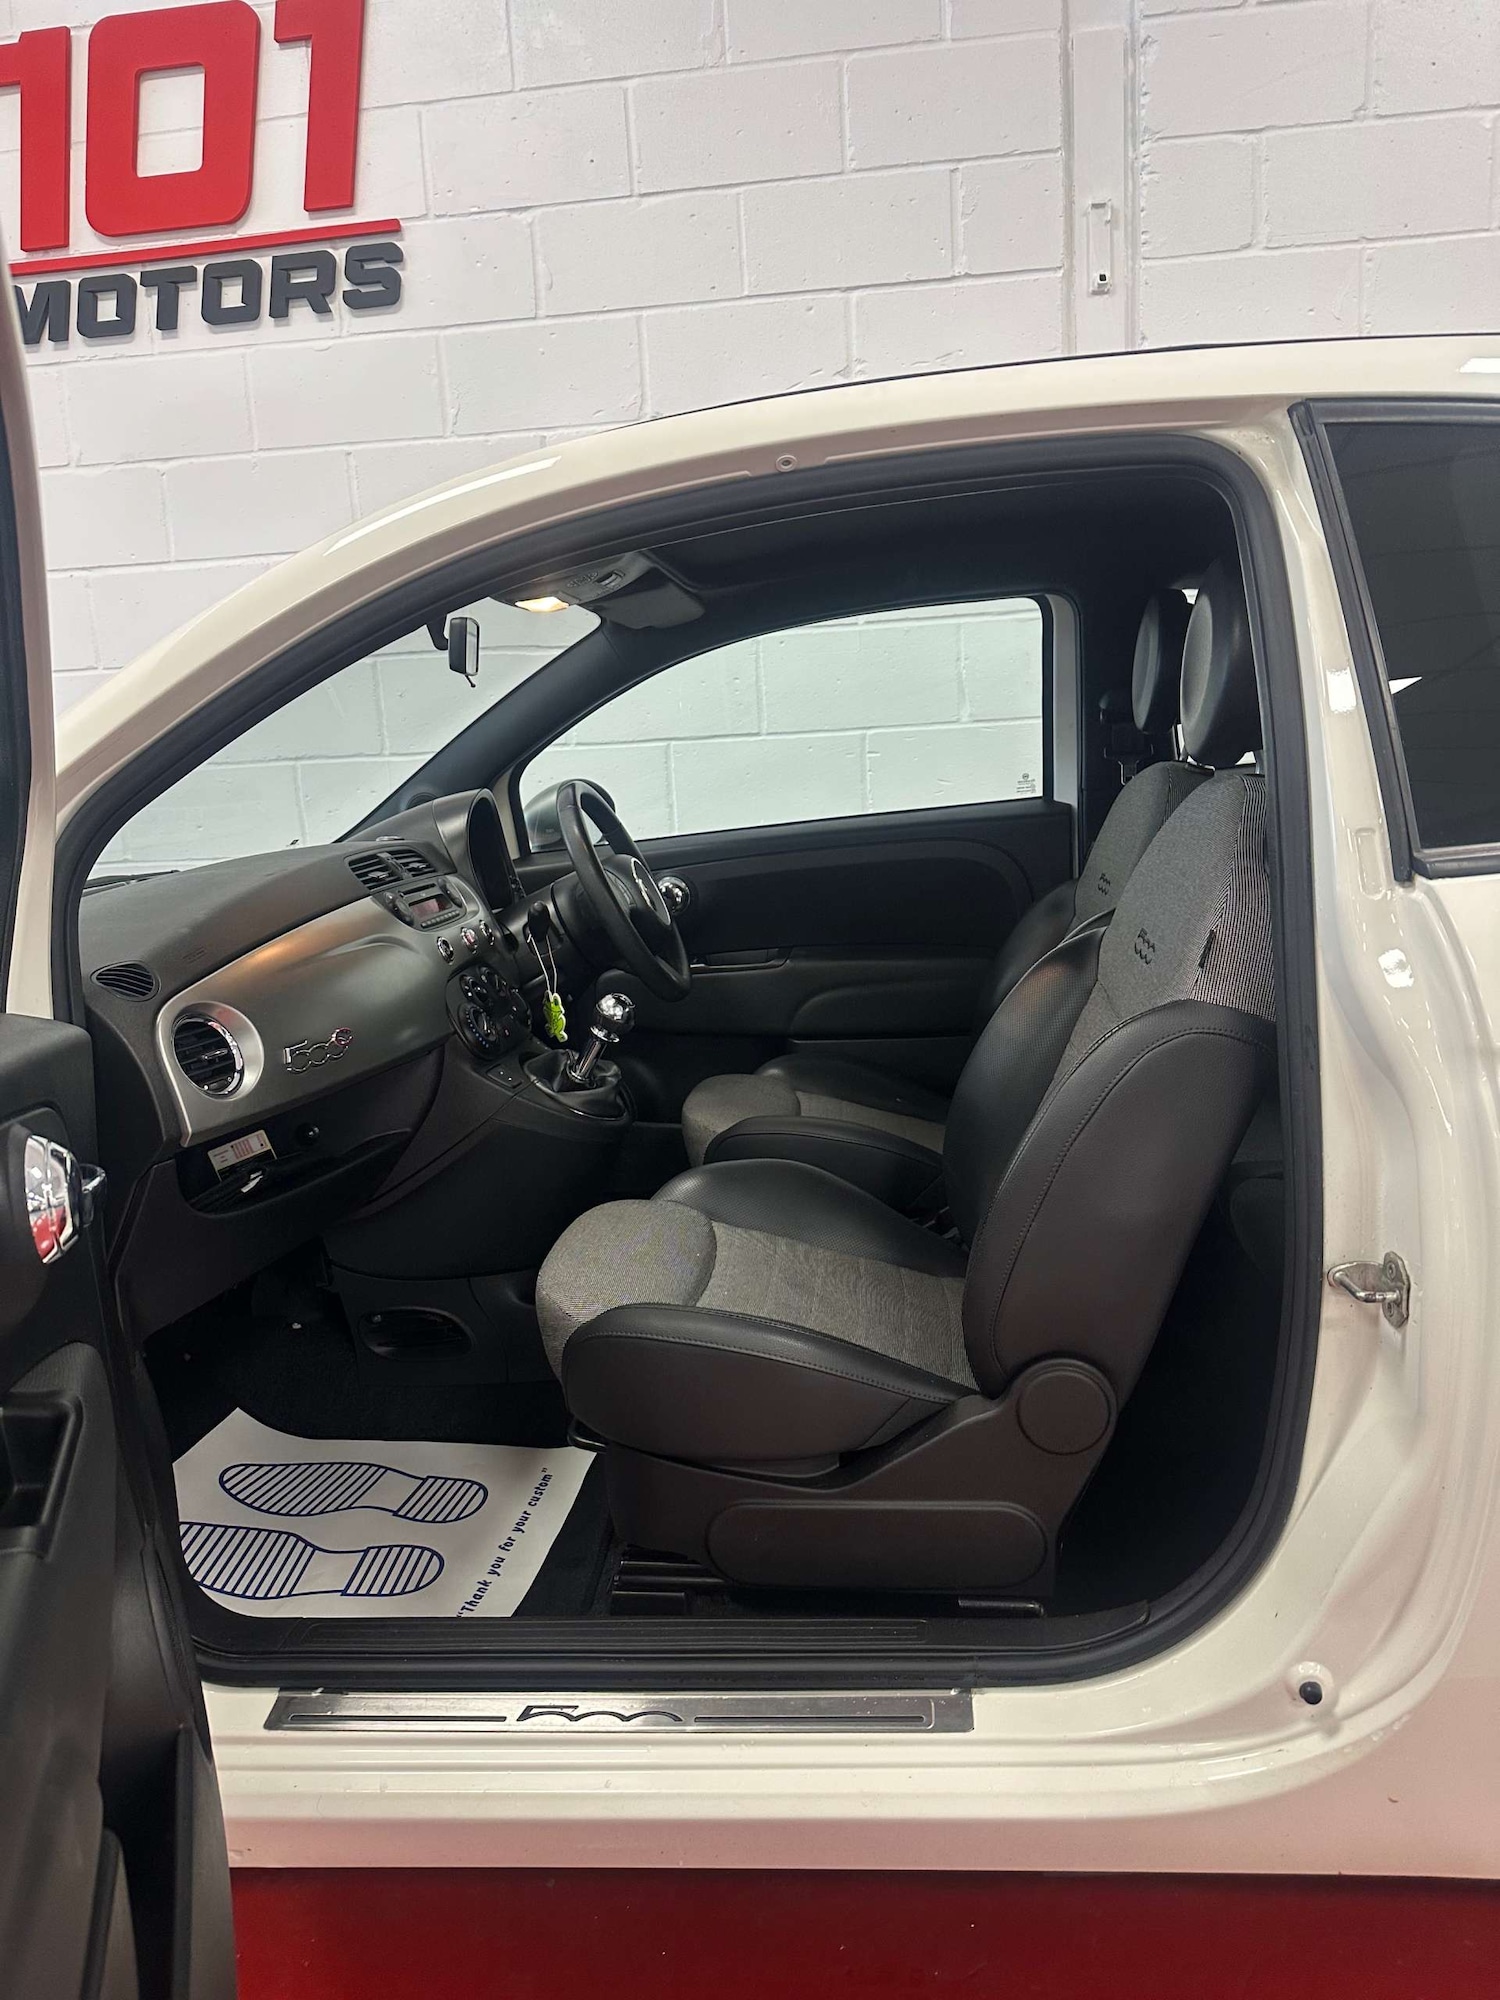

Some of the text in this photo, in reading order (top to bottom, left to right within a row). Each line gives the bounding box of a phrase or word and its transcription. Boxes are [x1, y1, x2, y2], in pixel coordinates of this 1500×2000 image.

[0, 0, 366, 252] 101
[14, 242, 404, 345] MOTORS
[487, 1556, 506, 1577] you
[498, 1536, 516, 1552] for
[512, 1510, 532, 1533] your
